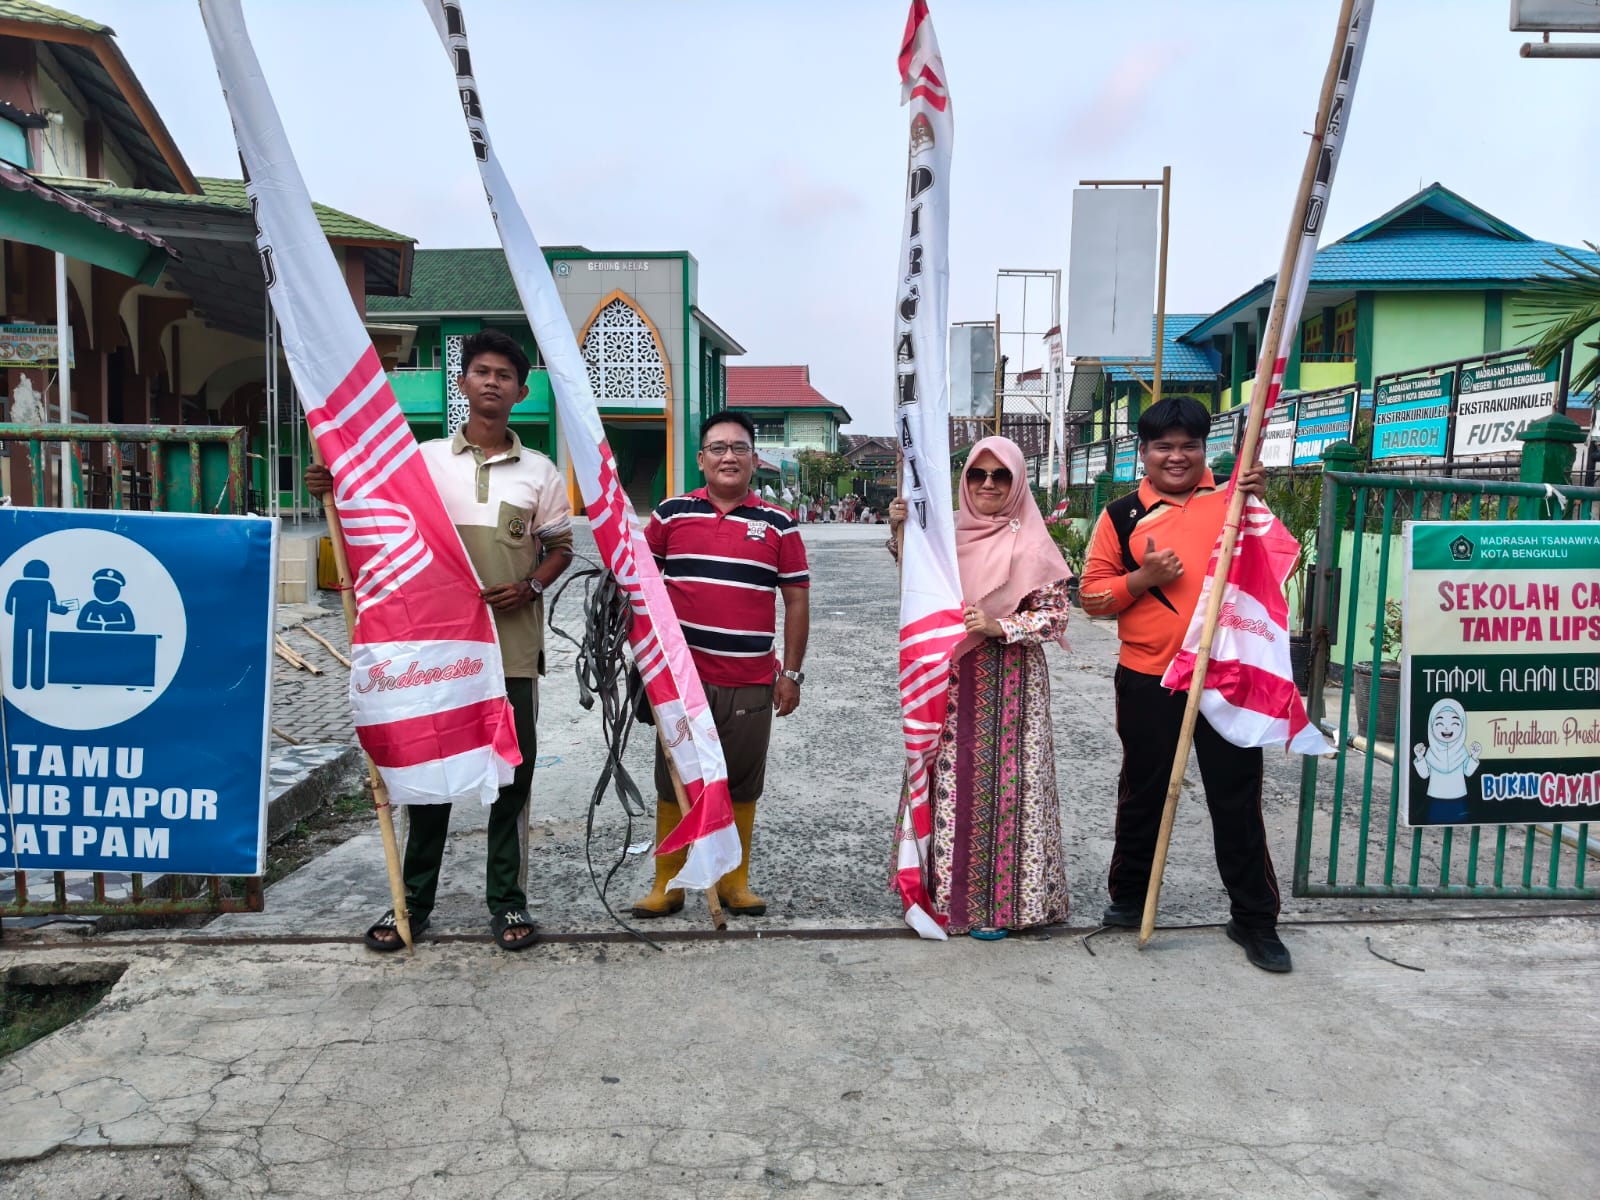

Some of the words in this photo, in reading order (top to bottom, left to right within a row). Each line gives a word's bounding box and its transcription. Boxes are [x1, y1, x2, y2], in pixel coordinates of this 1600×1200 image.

[1472, 380, 1492, 391] NEGERI
[1498, 377, 1512, 387] KOTA
[1514, 373, 1546, 384] BENGKULU
[1475, 366, 1504, 379] MADRASAH
[1506, 361, 1540, 374] TSANAWI
[1377, 405, 1448, 424] EKSTRAKURIKULER
[1459, 392, 1553, 416] EKSTRAKURIKULER
[1381, 427, 1439, 449] HADROH
[1467, 419, 1531, 445] FUTSA
[1294, 440, 1321, 458] DRUM
[1480, 536, 1538, 545] MADRASAH
[1480, 550, 1509, 558] KOTA
[1512, 549, 1568, 558] BENGKULU
[1438, 580, 1559, 612] SEKOLAH
[1460, 616, 1543, 642] TANPA
[1550, 615, 1600, 641] LIPS
[356, 657, 483, 693] Indonesia
[1422, 666, 1493, 693] TAMPIL
[1500, 665, 1557, 692] ALAMI
[1563, 667, 1600, 691] LEBI
[1488, 717, 1559, 754] Tingkatkan
[12, 744, 144, 779] TAMU
[1482, 773, 1539, 799] BUKAN
[0, 784, 71, 816] JIB
[83, 786, 218, 820] LAPOR
[0, 823, 170, 859] ATPAM
